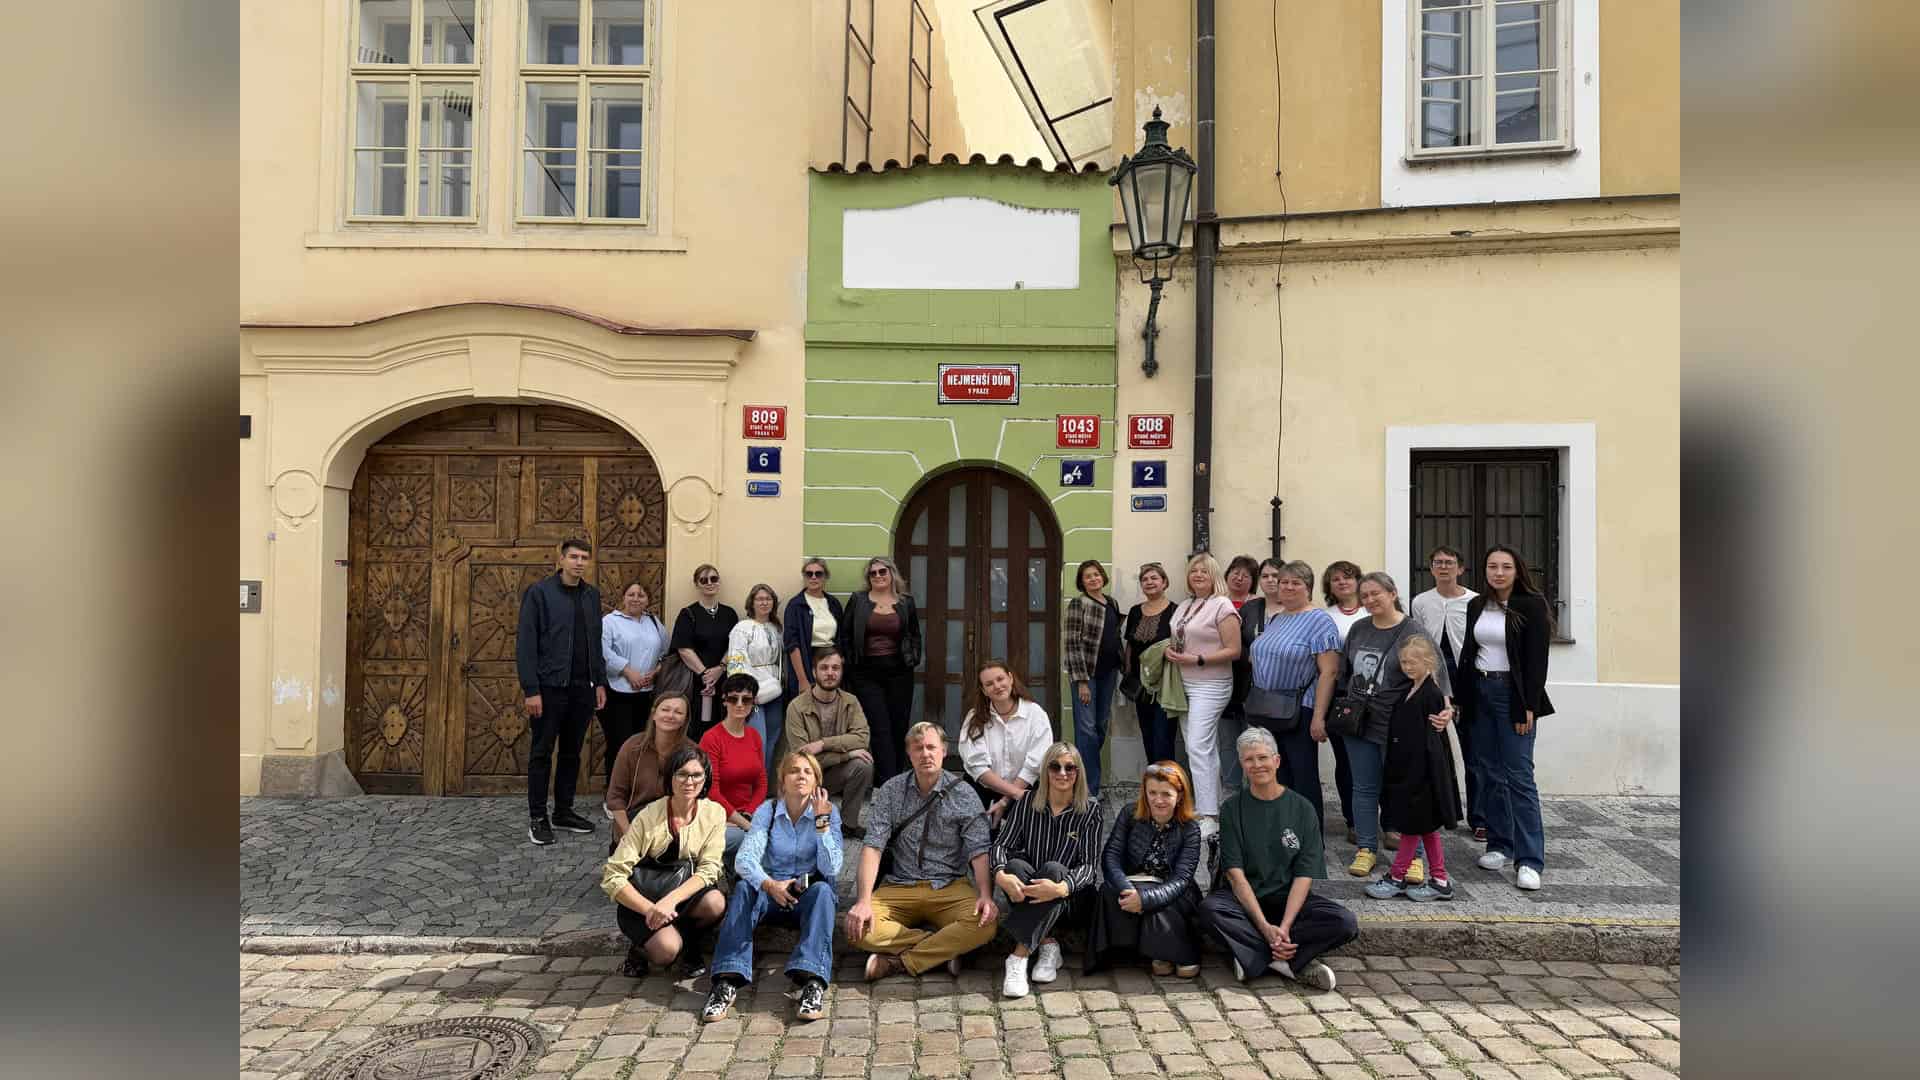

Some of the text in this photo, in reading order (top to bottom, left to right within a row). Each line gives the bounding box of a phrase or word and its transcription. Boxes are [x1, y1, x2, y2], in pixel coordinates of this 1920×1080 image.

[947, 372, 1011, 386] NEJMENŠÍ DŮM
[751, 410, 778, 424] 809
[1062, 419, 1094, 433] 1043
[1137, 418, 1164, 432] 808
[759, 452, 769, 467] 6
[1072, 465, 1082, 480] 4
[1143, 466, 1154, 481] 2
